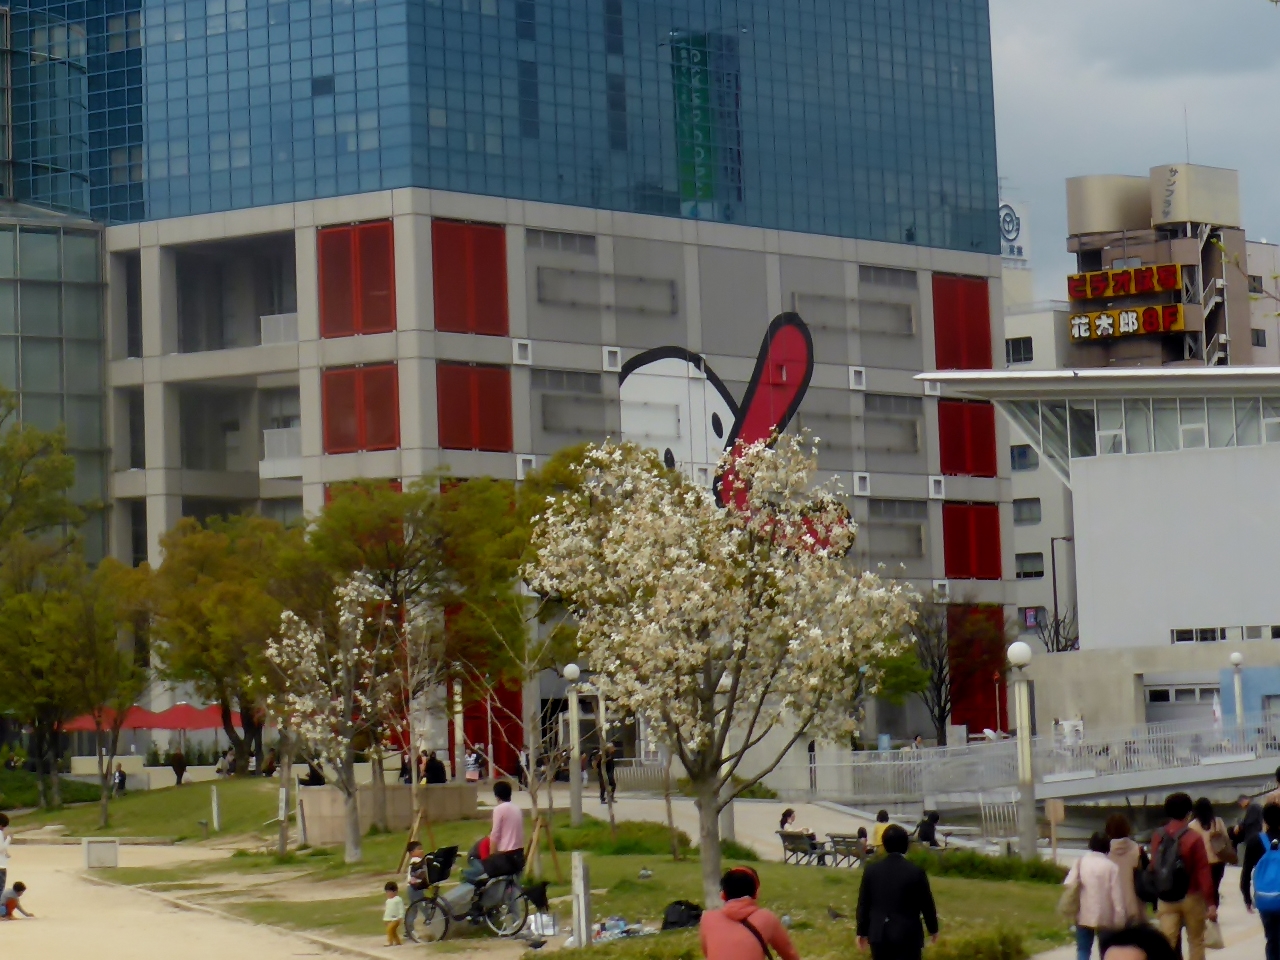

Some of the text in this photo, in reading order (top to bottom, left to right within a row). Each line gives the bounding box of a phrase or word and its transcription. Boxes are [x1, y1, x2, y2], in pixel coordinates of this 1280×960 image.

[1068, 266, 1178, 298] ビデオ試写
